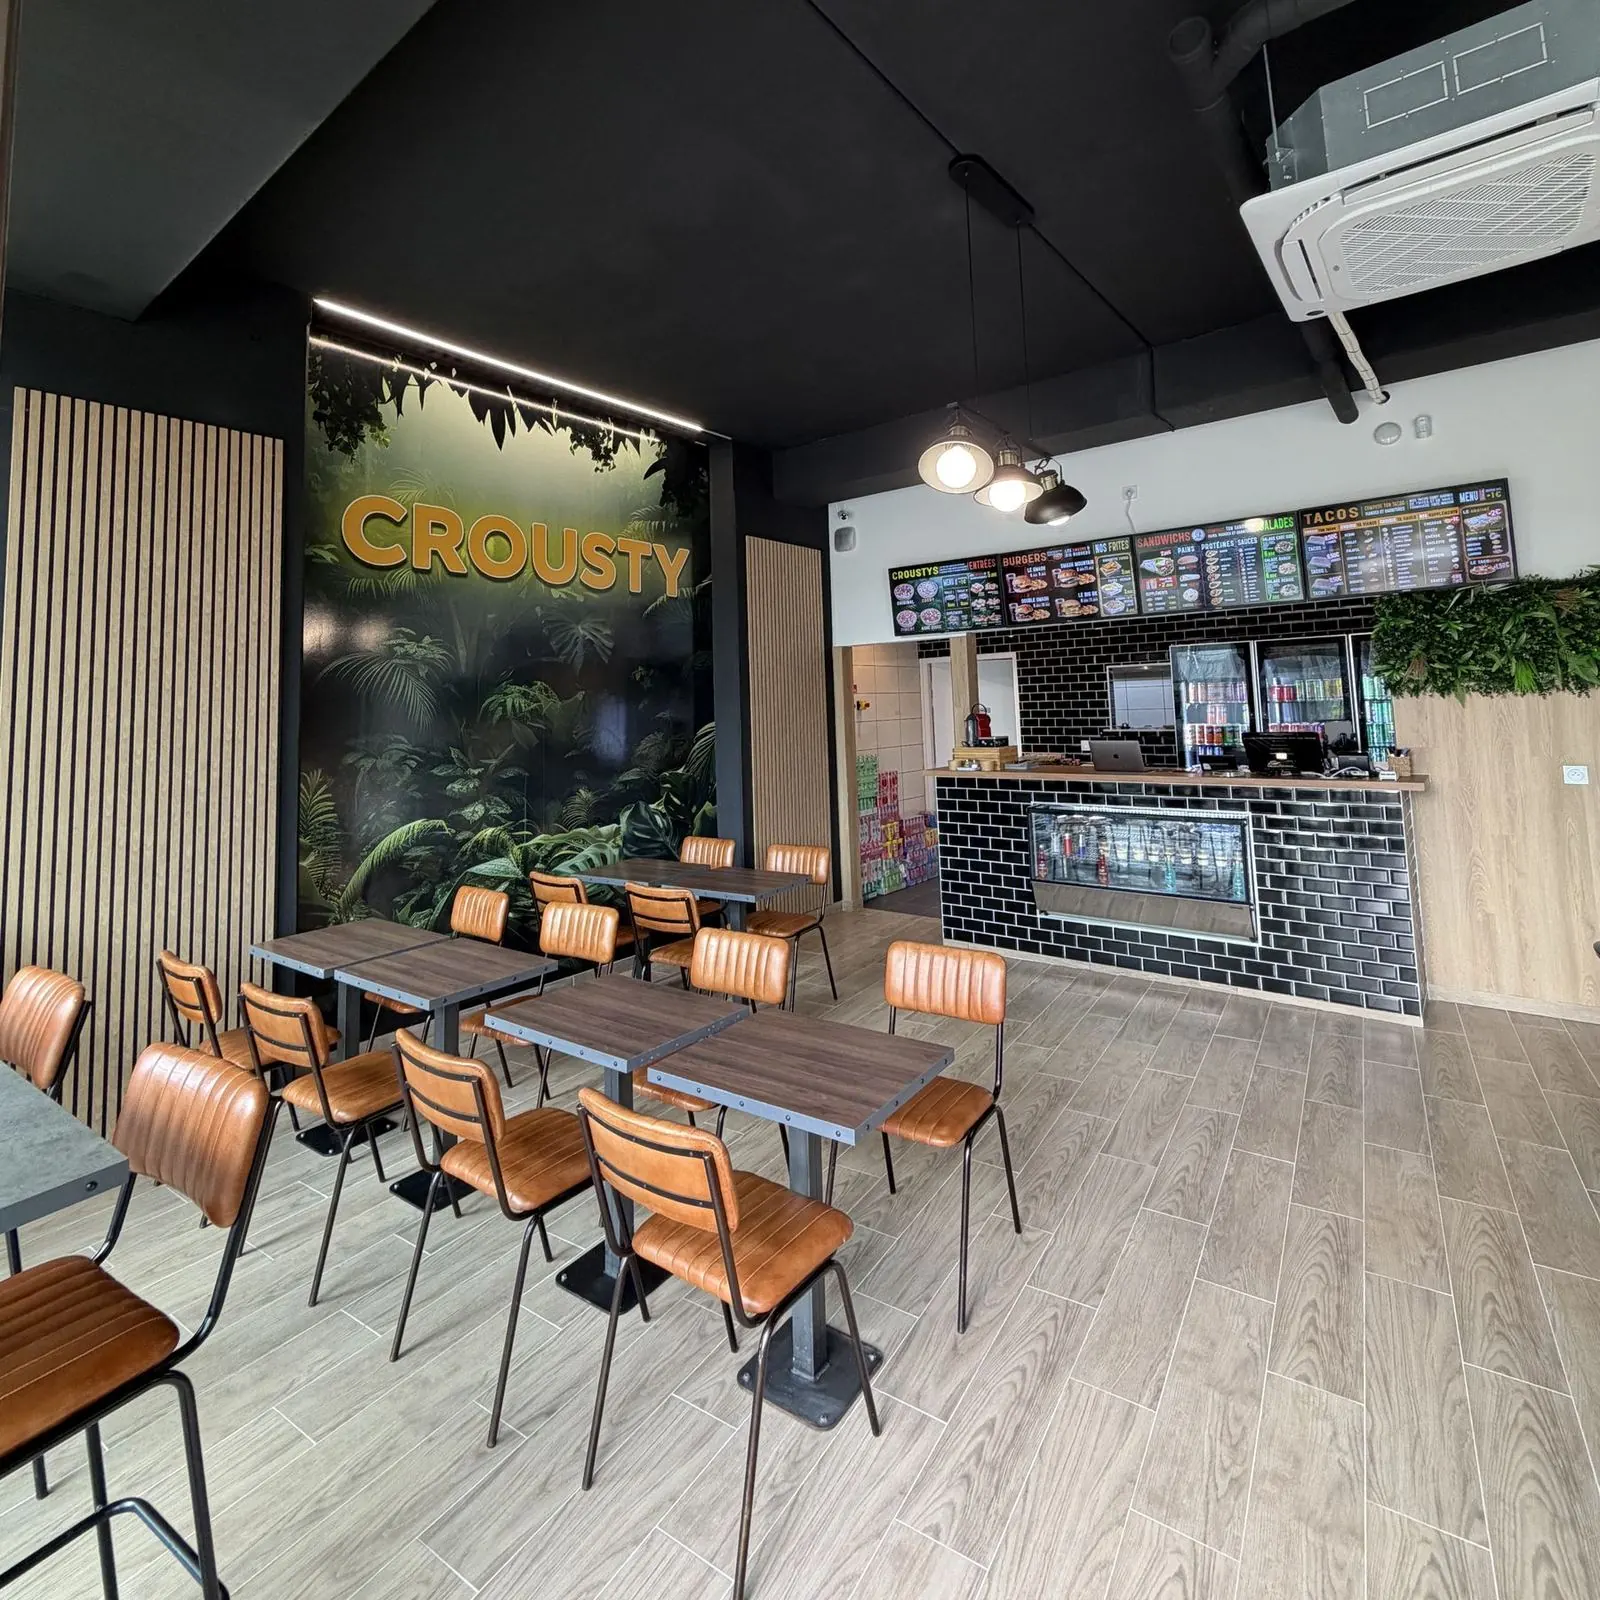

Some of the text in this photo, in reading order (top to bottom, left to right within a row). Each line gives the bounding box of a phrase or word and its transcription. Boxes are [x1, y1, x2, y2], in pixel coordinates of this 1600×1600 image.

[1459, 490, 1479, 503] MENU
[1303, 506, 1359, 525] TACOS
[1258, 517, 1294, 532] ALADES
[1137, 531, 1191, 548] SANDWICHS
[1201, 540, 1235, 550] PROTÉINES
[1237, 536, 1258, 546] SAUCES
[341, 494, 691, 599] CROUSTY
[1095, 543, 1107, 553] NOS
[1108, 540, 1130, 552] FRITES
[1177, 545, 1195, 554] PAINS
[969, 558, 996, 570] ENTRÉES
[1003, 552, 1047, 567] BURGERS
[892, 566, 939, 580] CROUSTYS
